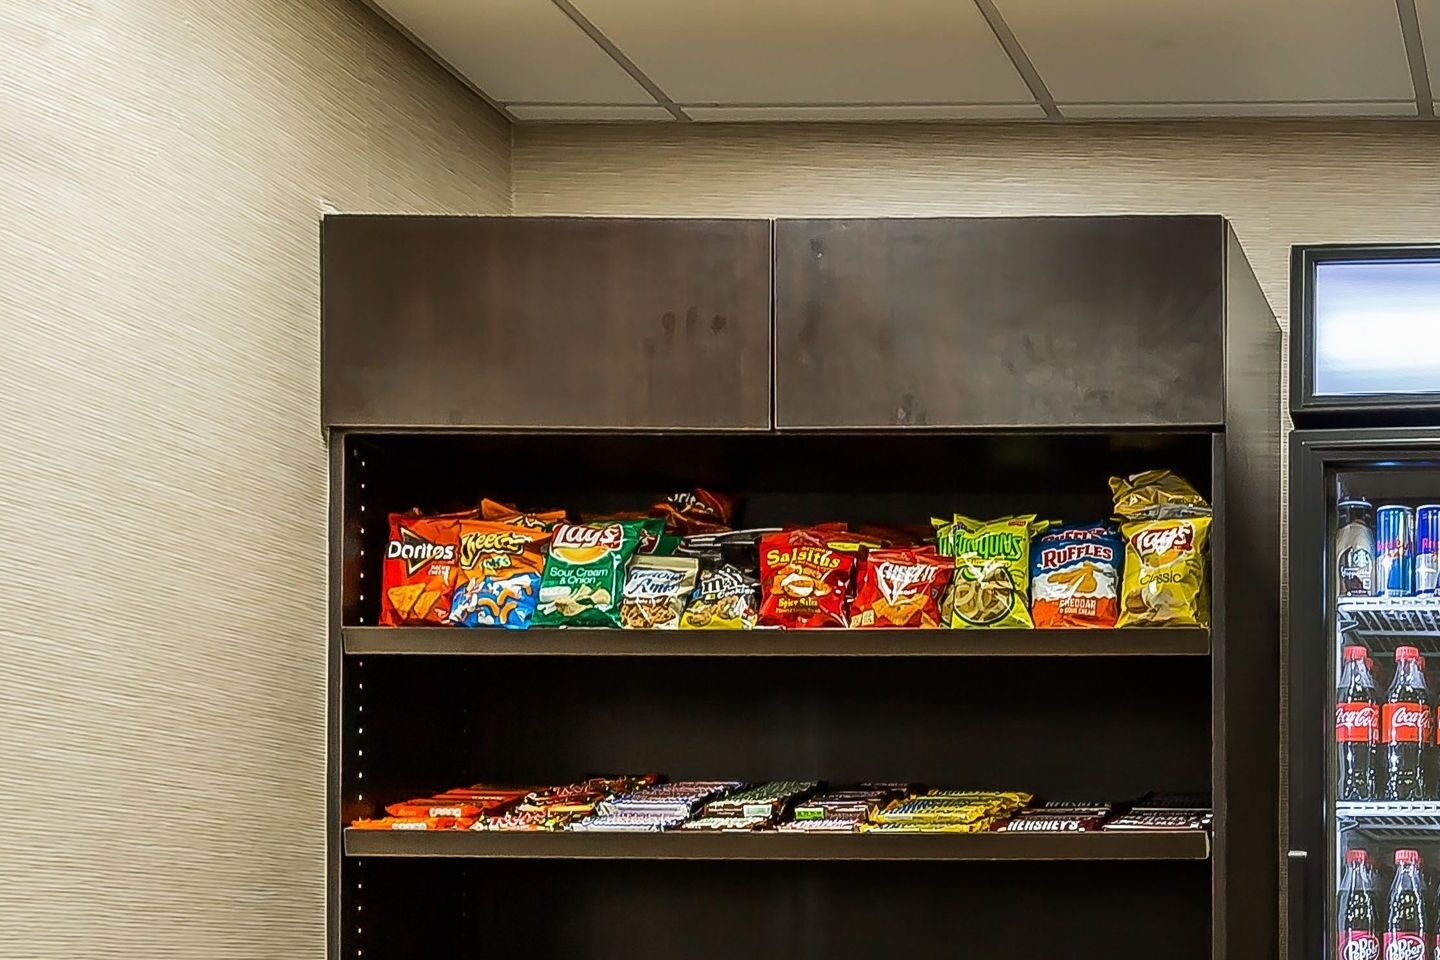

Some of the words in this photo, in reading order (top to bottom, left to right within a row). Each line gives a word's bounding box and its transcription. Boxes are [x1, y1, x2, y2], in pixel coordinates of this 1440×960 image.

[387, 541, 454, 560] Doritos
[1043, 545, 1113, 568] RUFFLES
[550, 567, 574, 577] Sour
[576, 567, 608, 577] Cream
[1140, 571, 1182, 586] Classic
[568, 576, 596, 584] Onion
[1398, 937, 1413, 951] Dr
